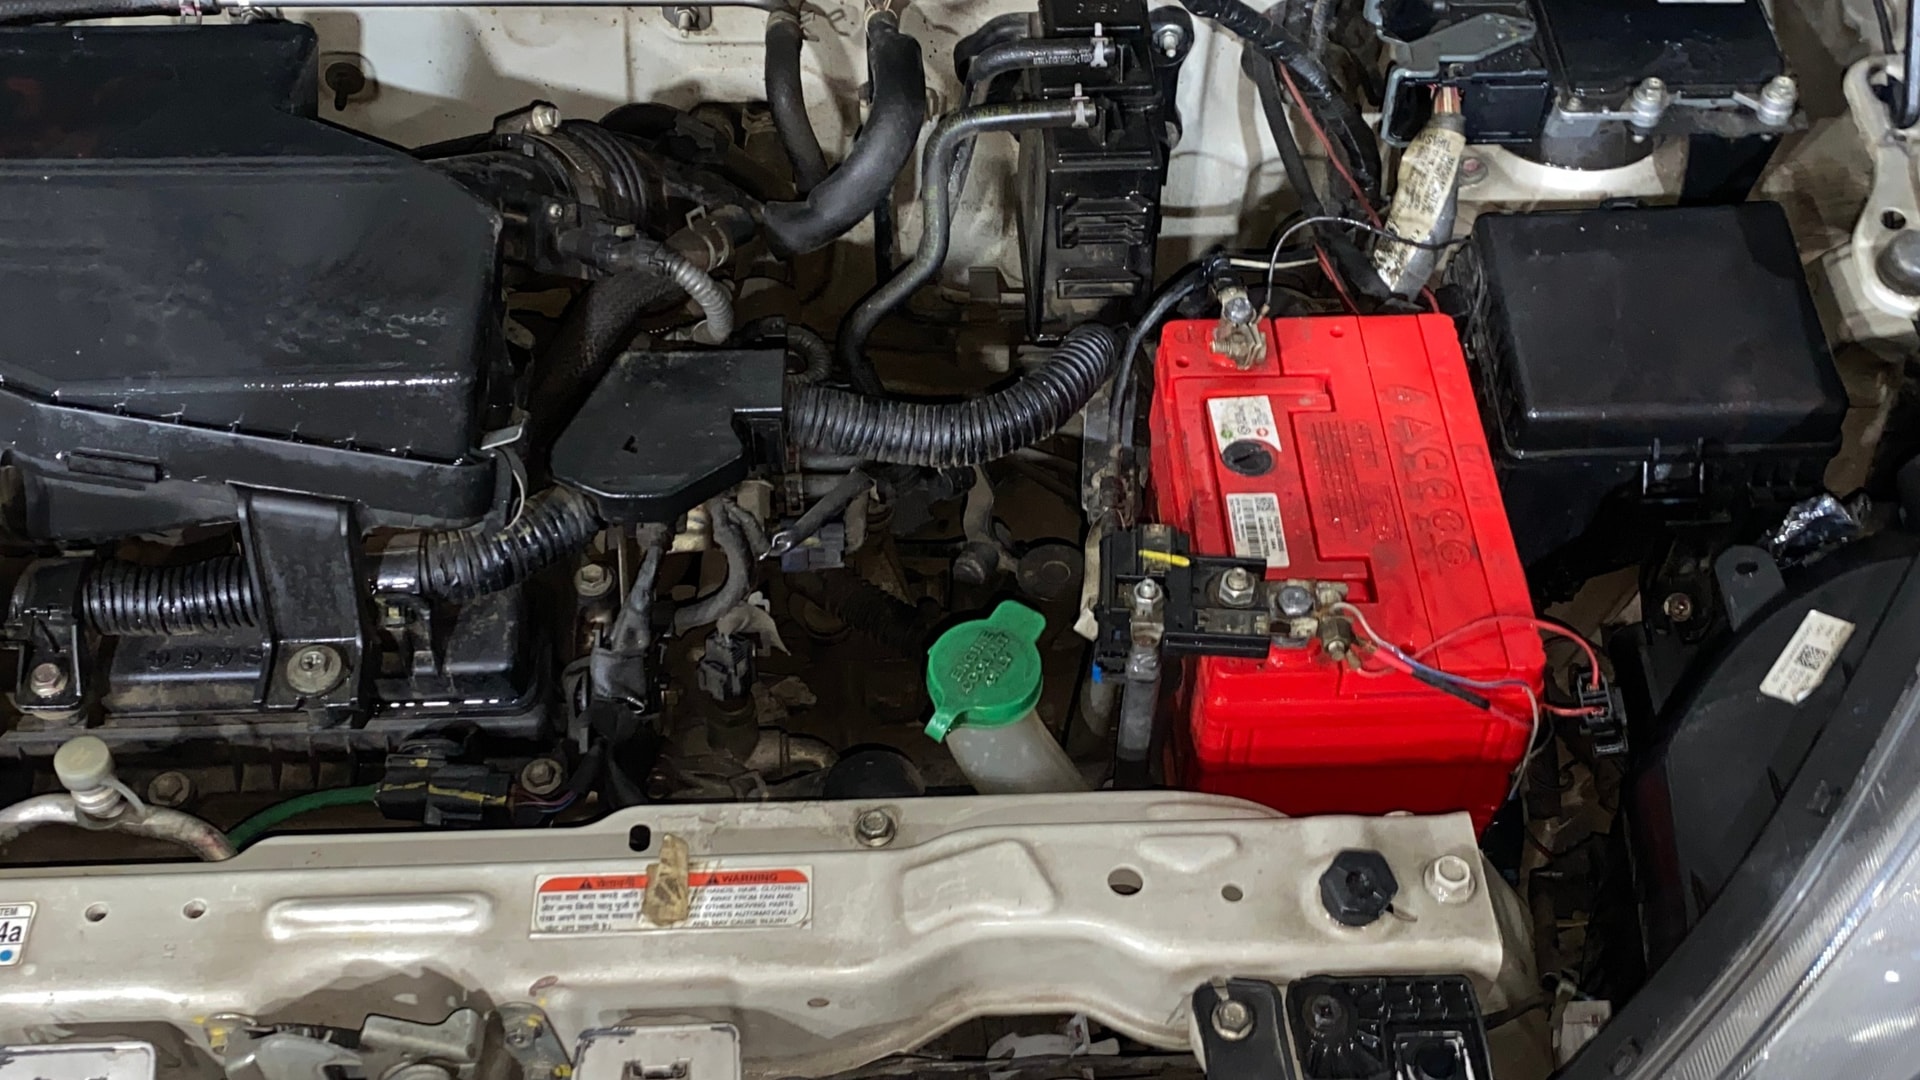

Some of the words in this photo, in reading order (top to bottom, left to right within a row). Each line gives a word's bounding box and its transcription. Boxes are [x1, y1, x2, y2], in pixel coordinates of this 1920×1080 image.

[722, 873, 778, 883] WARNING
[0, 907, 18, 916] TEM
[0, 921, 22, 943] 4a
